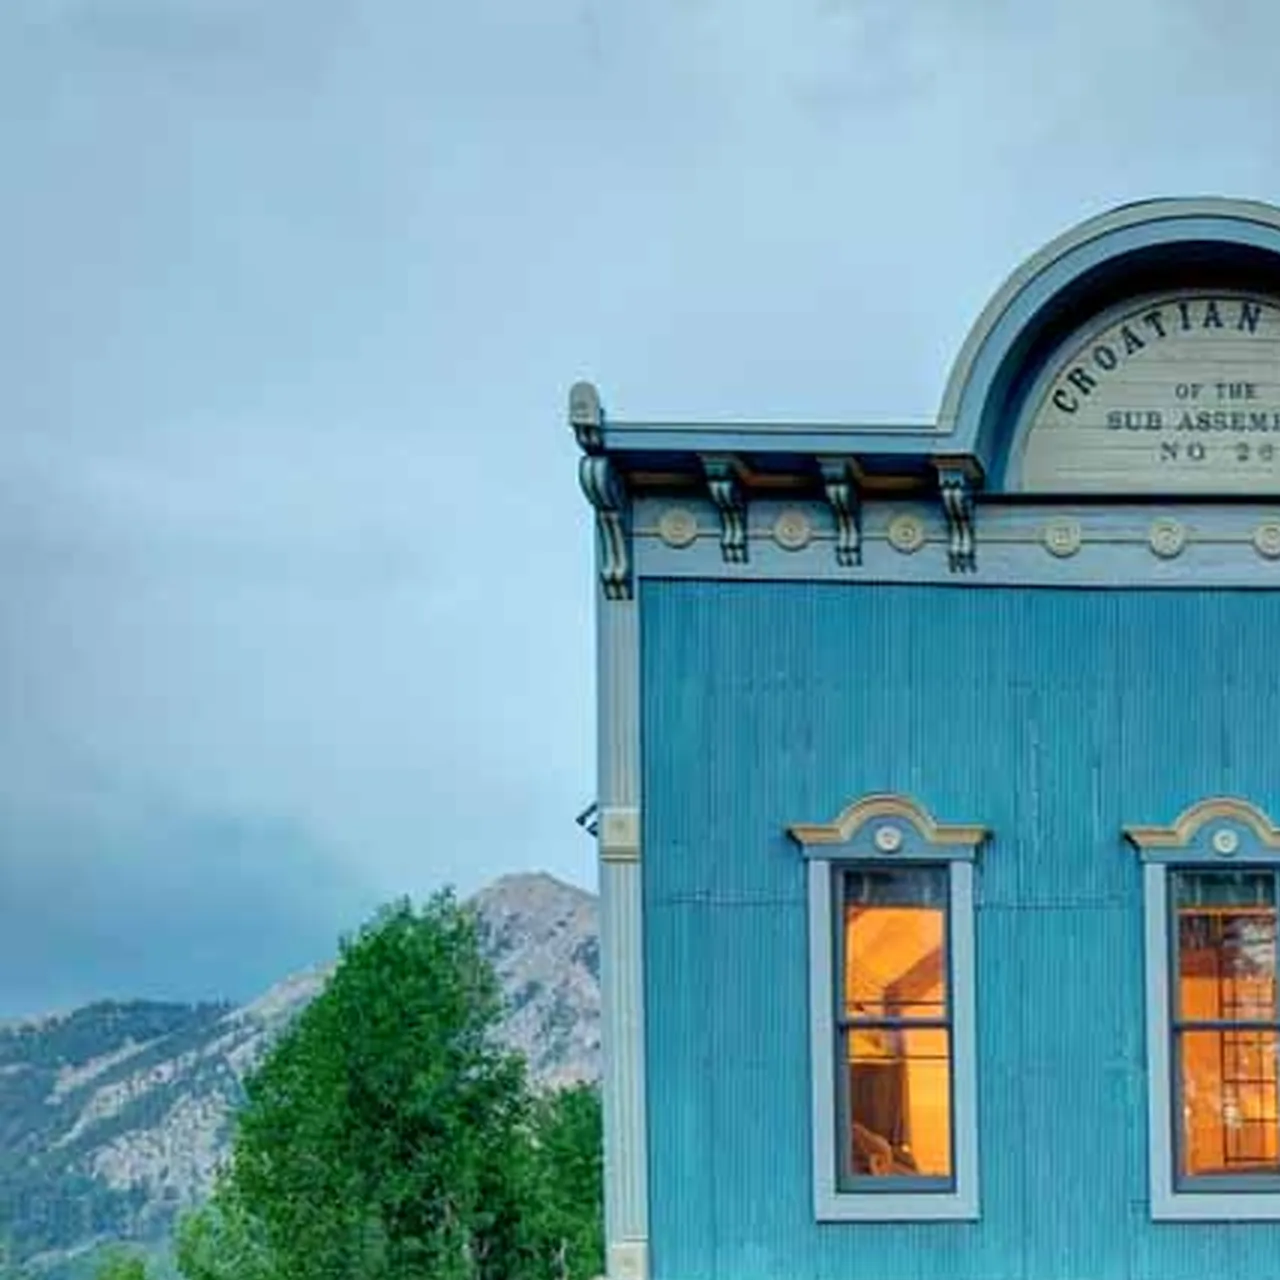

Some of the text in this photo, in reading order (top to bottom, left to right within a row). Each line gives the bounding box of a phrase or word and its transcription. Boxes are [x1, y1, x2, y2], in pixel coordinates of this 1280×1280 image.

[1052, 300, 1263, 415] CROATIAN
[1175, 383, 1260, 400] OF THE
[1106, 411, 1163, 431] SUB
